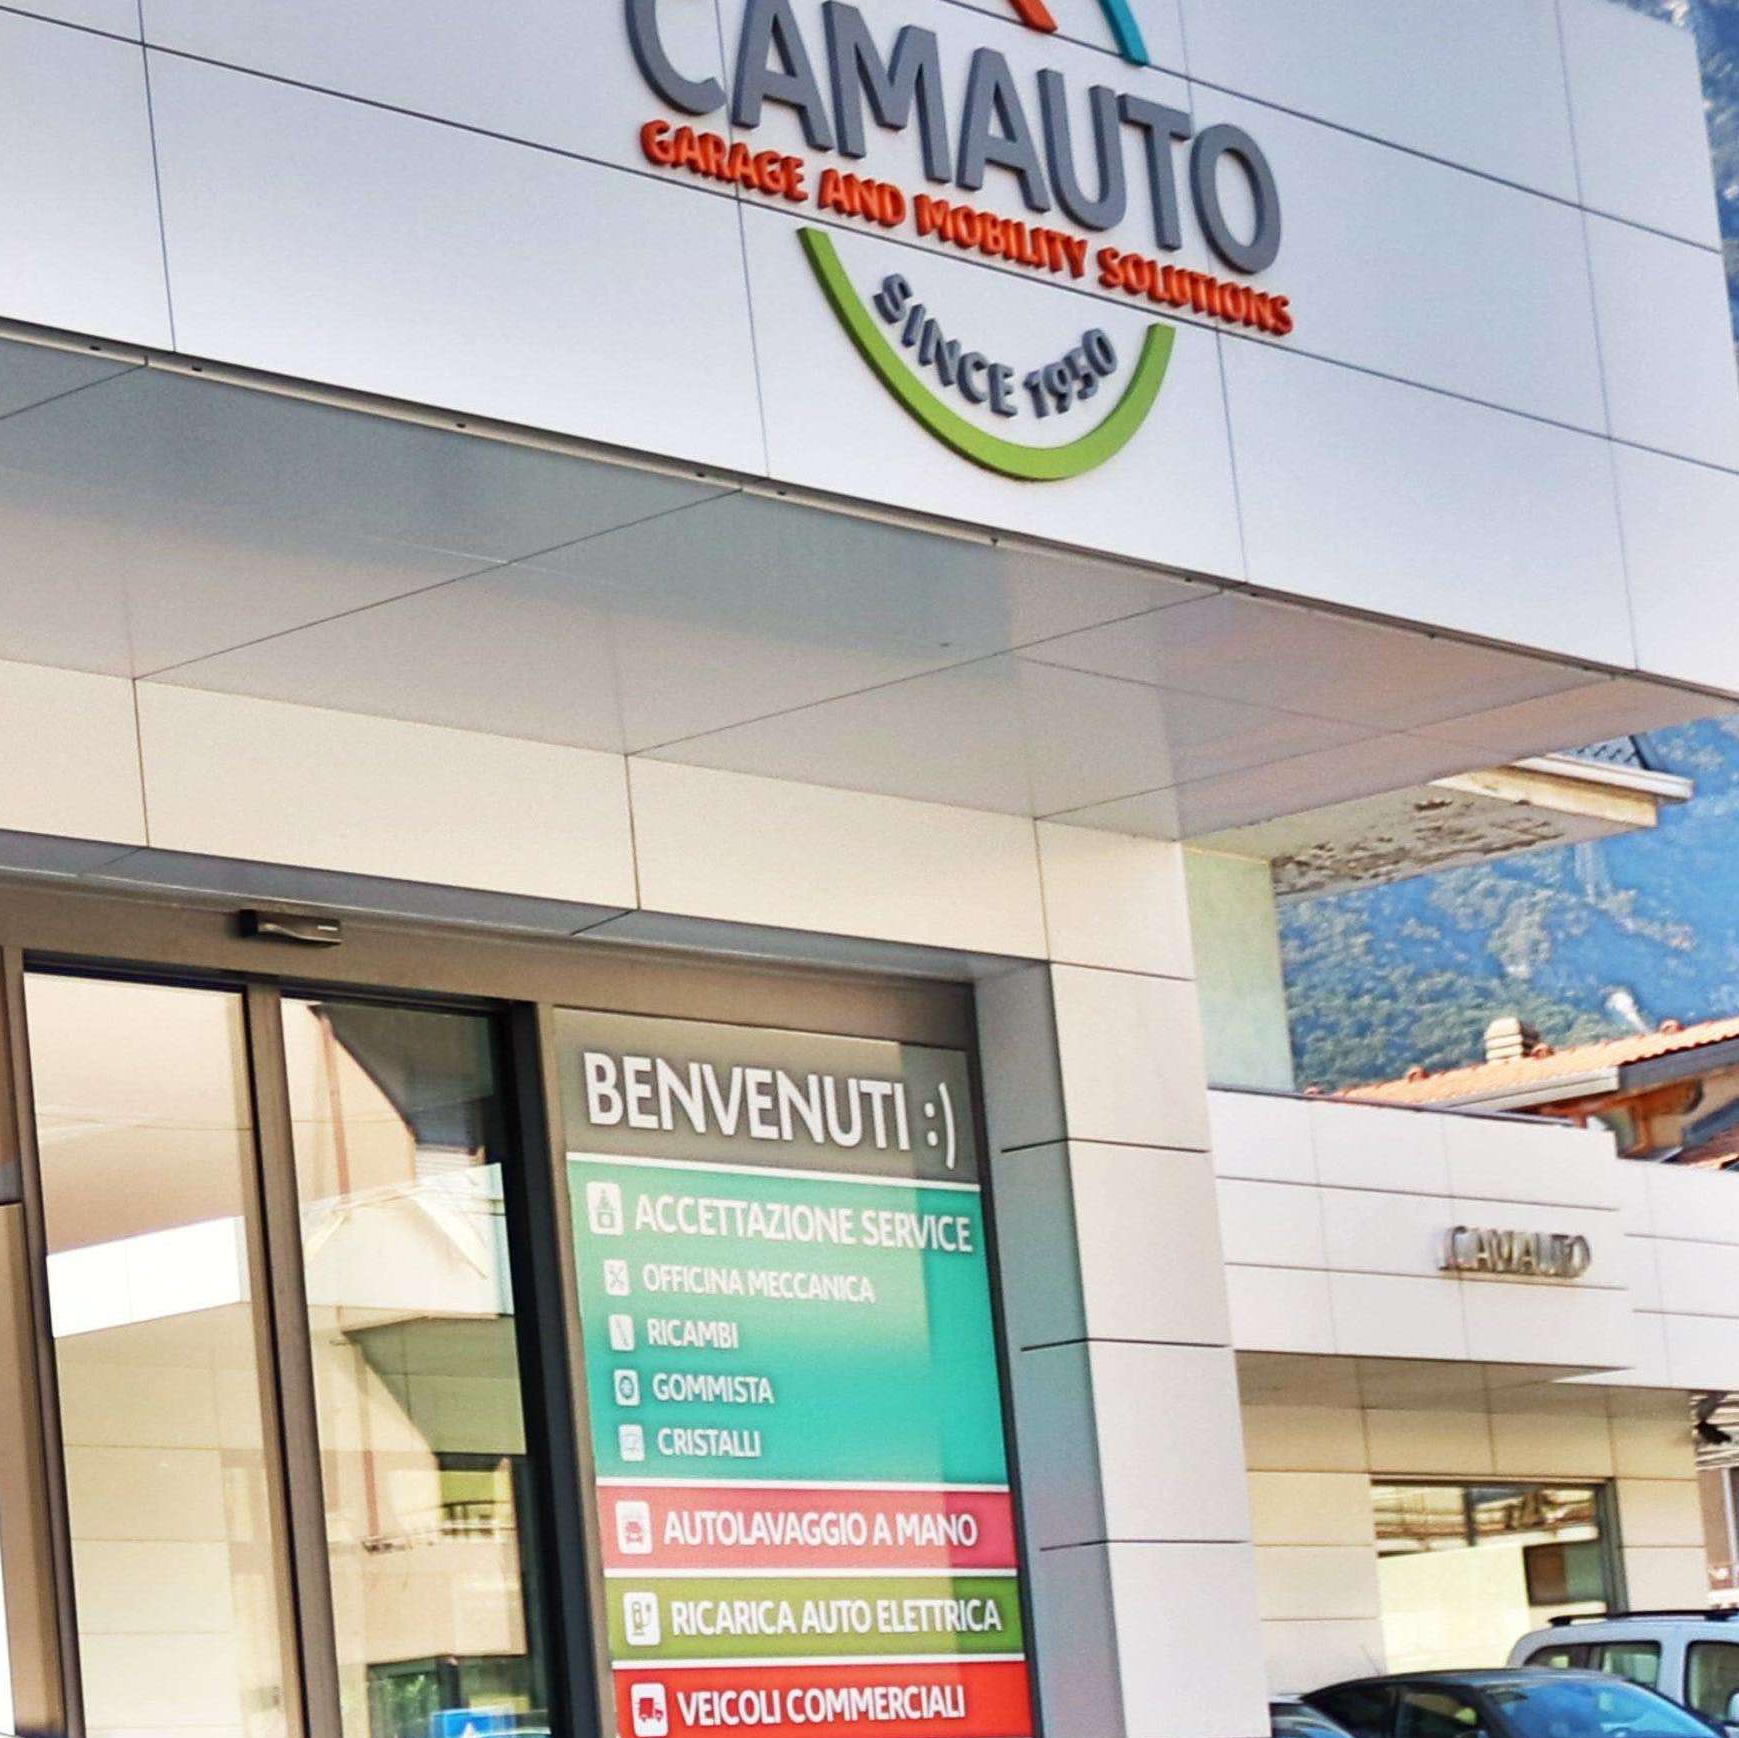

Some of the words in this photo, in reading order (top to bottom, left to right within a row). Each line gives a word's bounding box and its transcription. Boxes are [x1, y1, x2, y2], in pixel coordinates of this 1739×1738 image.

[624, 0, 1281, 274] CAMAUTO
[640, 119, 807, 201] GARAGE
[818, 168, 905, 226] AND
[914, 194, 1087, 278] MOBILITY
[1097, 246, 1293, 336] SOLUTIONS
[873, 273, 1017, 418] SINCE
[1024, 328, 1117, 418] 1950
[583, 1052, 911, 1150] BENVENUTI
[635, 1195, 855, 1244] ACCETTAZIONE
[862, 1210, 973, 1253] SERVICE
[642, 1264, 743, 1296] OFFICINA
[748, 1269, 875, 1303] MECCANICA
[647, 1318, 738, 1349] RICAMBI
[652, 1372, 775, 1404] GOMMISTA
[657, 1427, 761, 1457] CRISTALLI
[664, 1512, 868, 1546] AUTOLAVAGGIO
[874, 1513, 893, 1546] A
[898, 1513, 978, 1547] MANO
[671, 1601, 796, 1636] RICARICA
[802, 1600, 872, 1634] AUTO
[878, 1599, 1002, 1632] ELETTRICA
[677, 1689, 781, 1726] VEICOLI
[787, 1685, 965, 1723] COMMERCIALI
